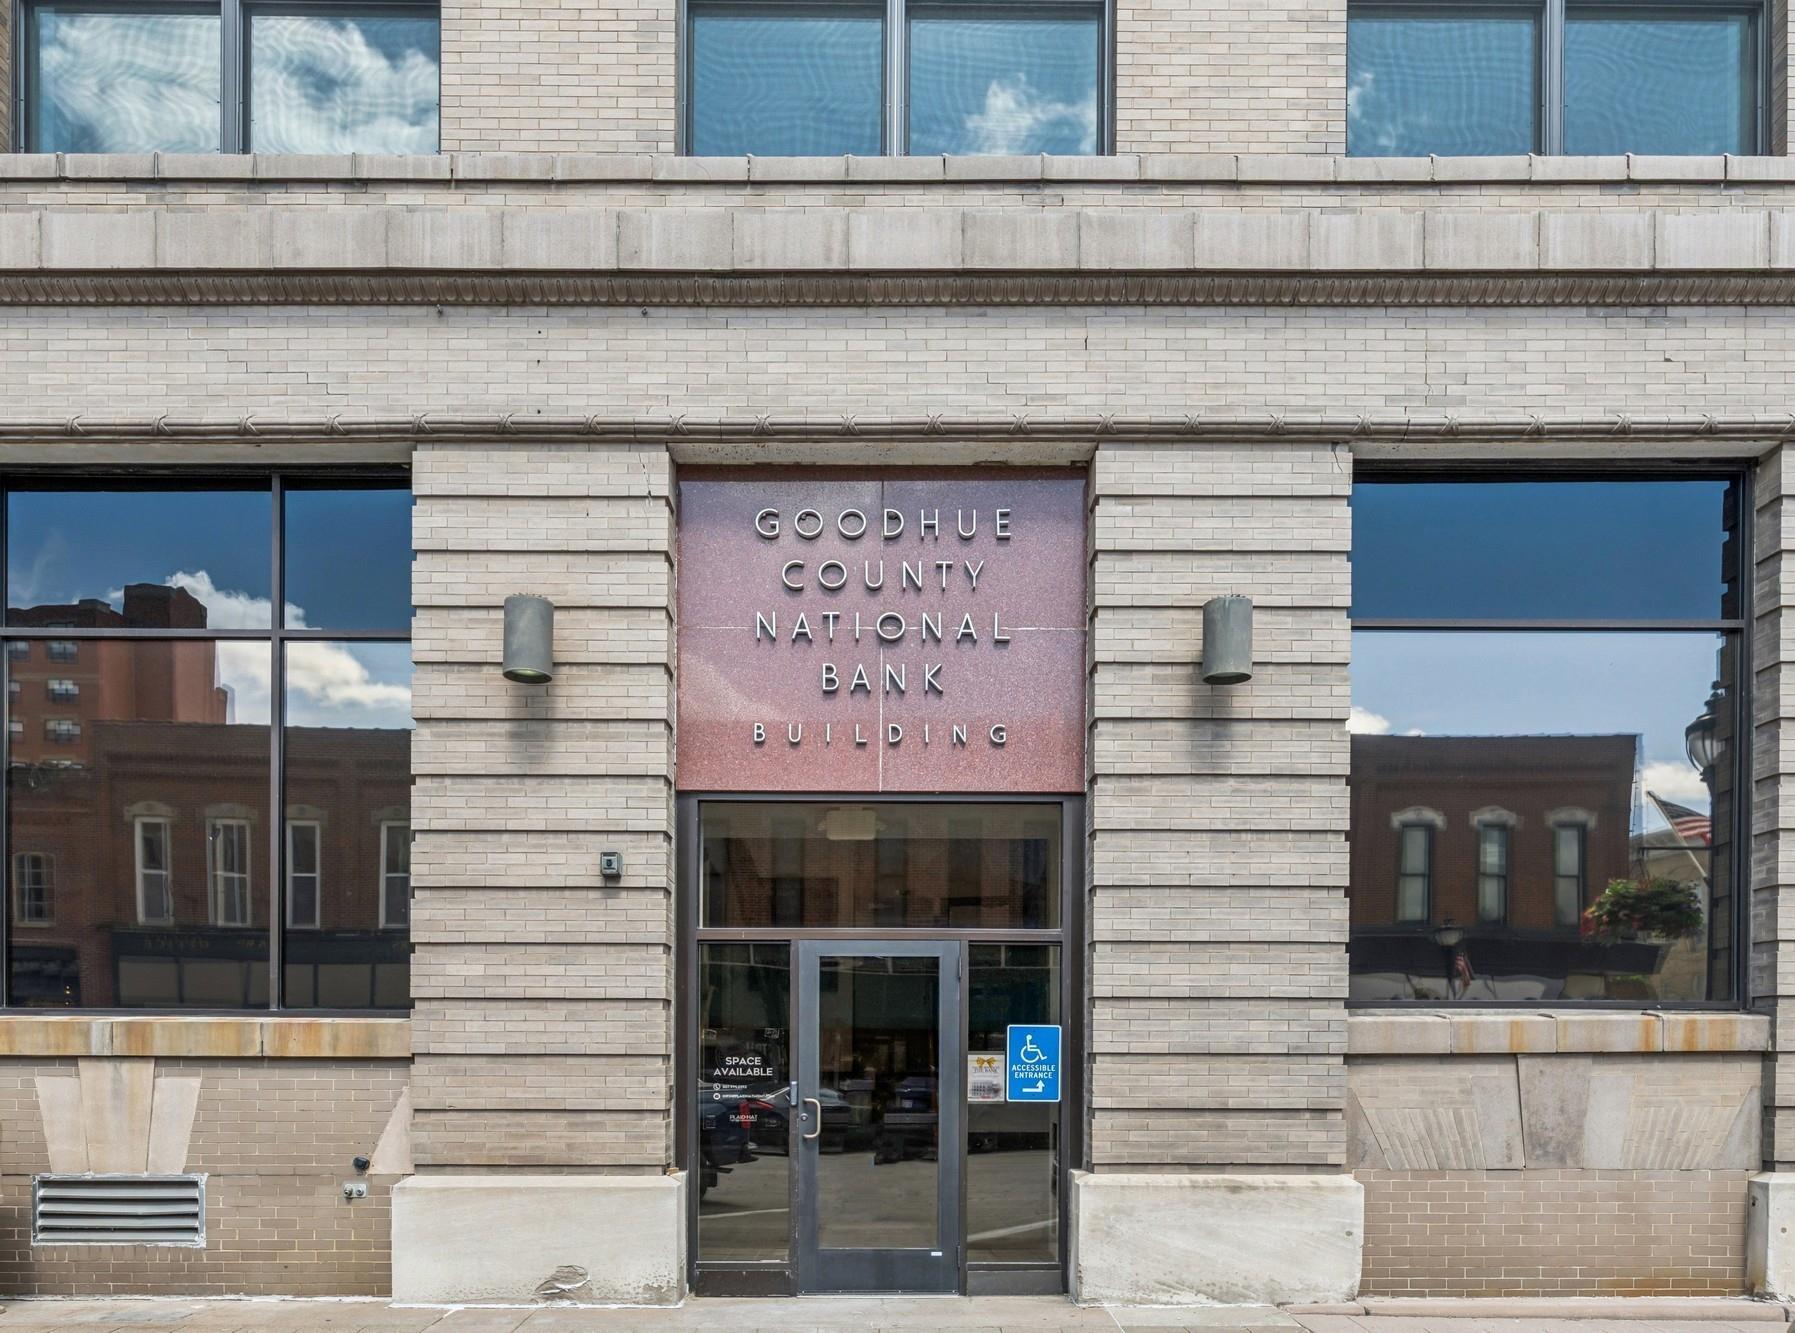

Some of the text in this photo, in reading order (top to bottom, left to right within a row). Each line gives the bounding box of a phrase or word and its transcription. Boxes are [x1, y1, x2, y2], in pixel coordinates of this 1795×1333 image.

[755, 508, 1012, 540] GOODHUE
[782, 560, 984, 591] COUNTY
[756, 611, 1011, 642] NATIONAL
[821, 663, 944, 694] BANK
[753, 723, 1007, 745] BUILDING
[713, 1067, 774, 1076] AVAILABLE
[725, 1056, 762, 1065] SPACE
[1011, 1064, 1056, 1072] ACCESSIBLE
[1014, 1071, 1053, 1079] ENTRANCE
